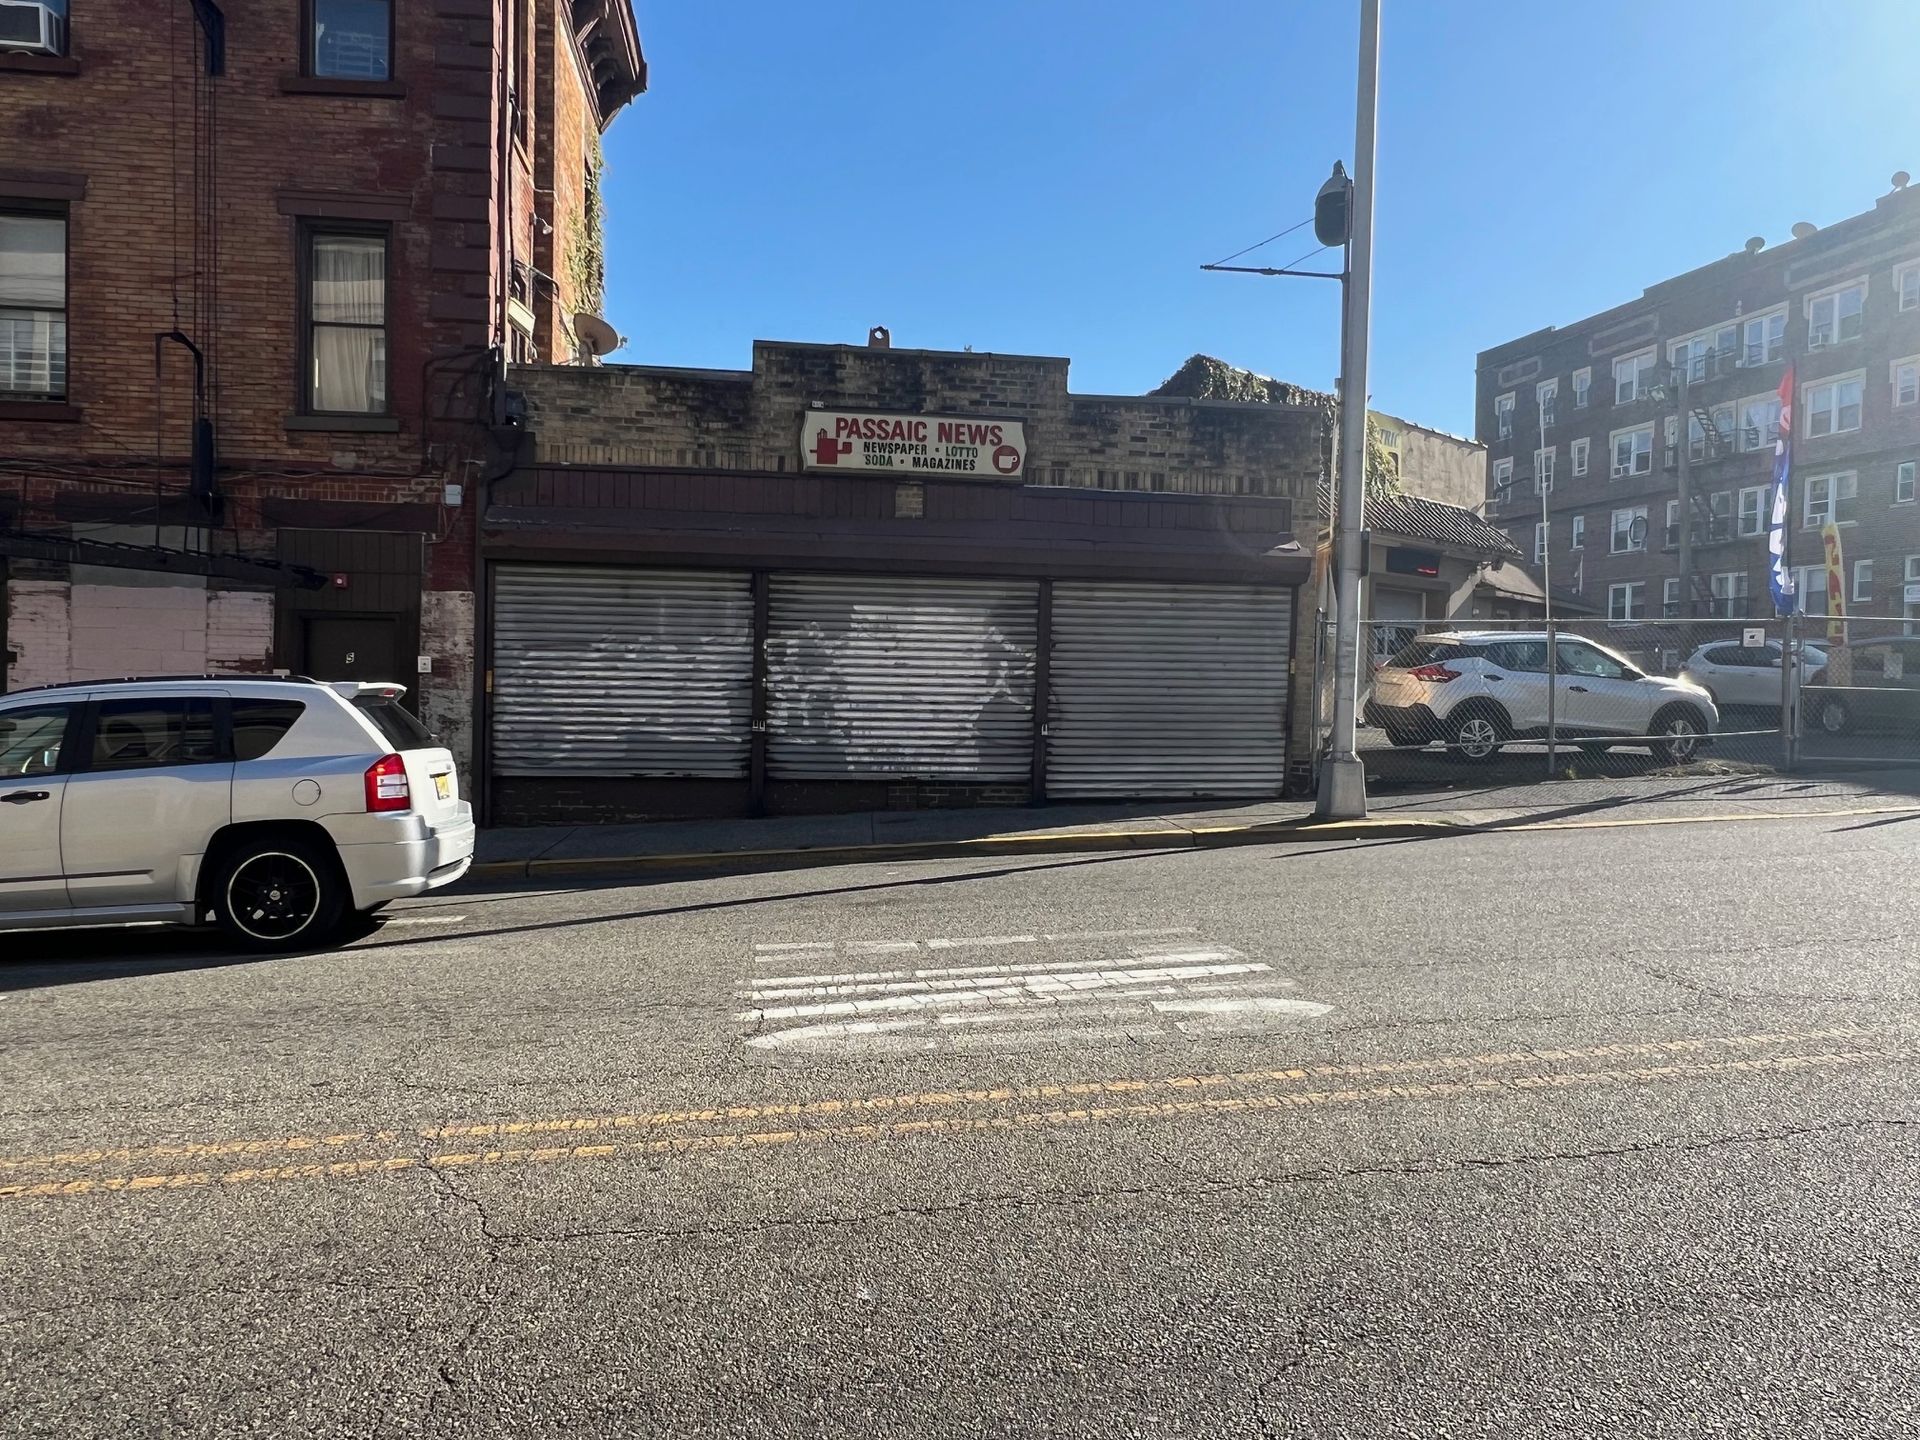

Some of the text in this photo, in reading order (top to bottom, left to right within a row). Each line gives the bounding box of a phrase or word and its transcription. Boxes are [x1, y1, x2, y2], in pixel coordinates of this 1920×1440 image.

[836, 417, 1003, 446] PASSAIC NEWS
[863, 441, 978, 458] NEWSPAPER LOTTO
[865, 454, 976, 471] SODA MAGAZINES
